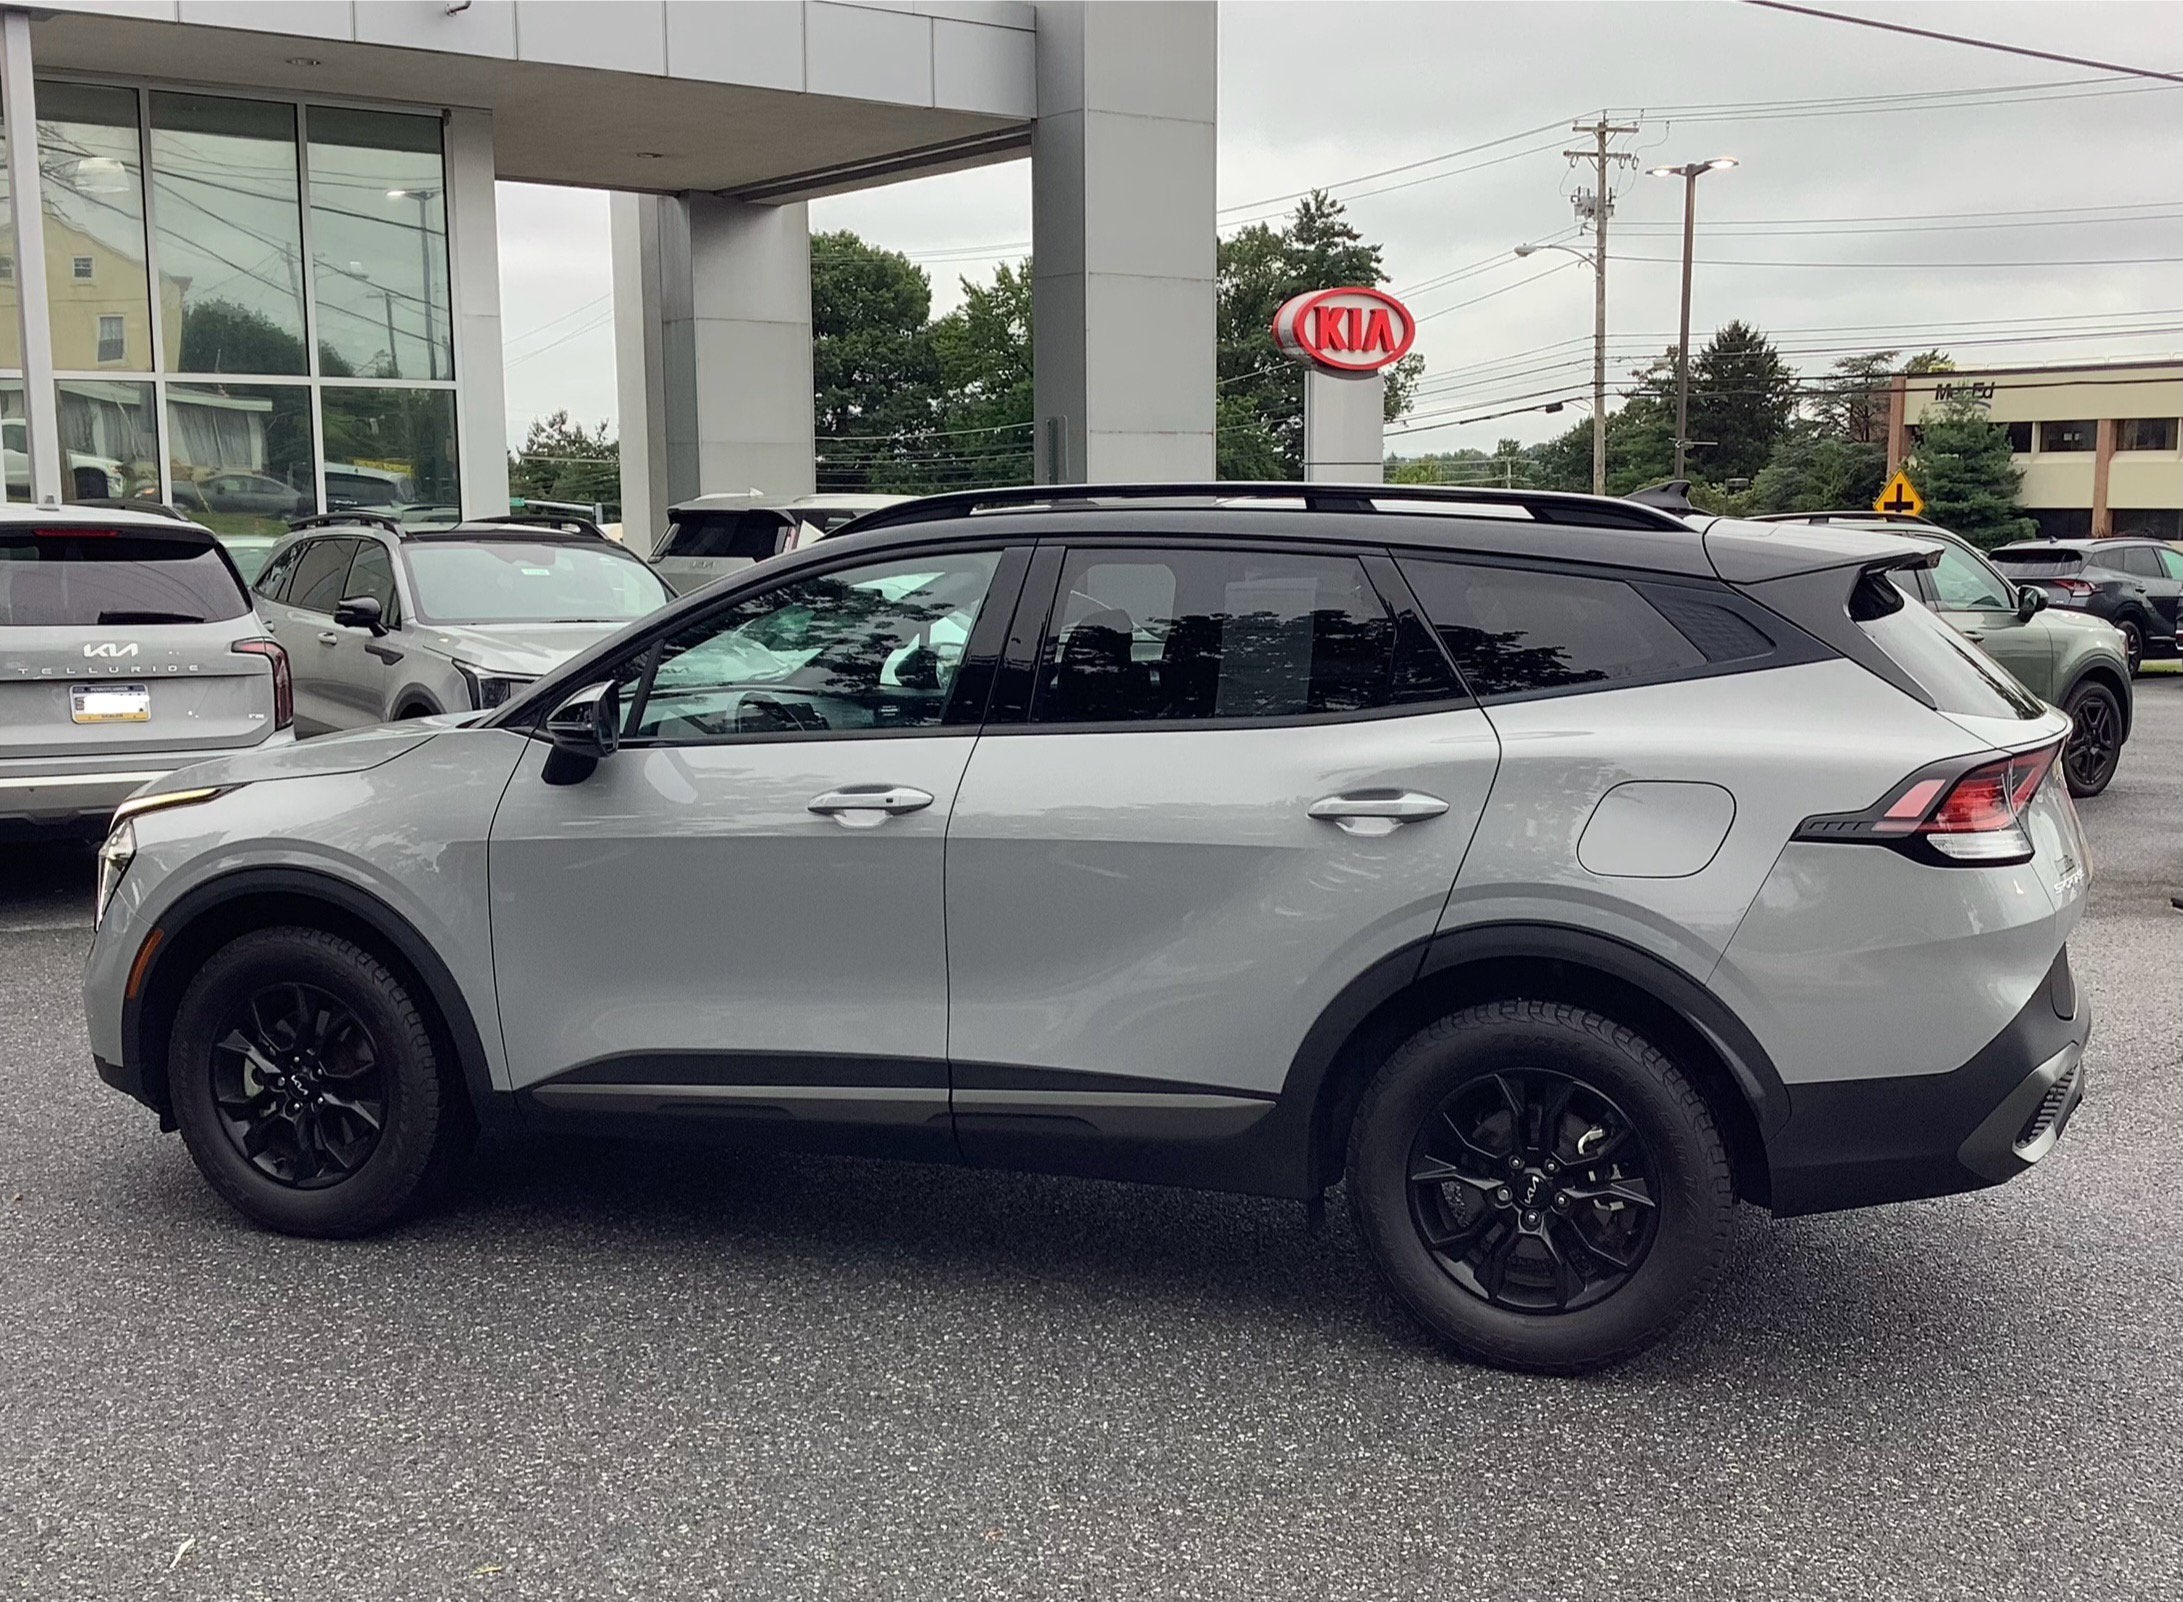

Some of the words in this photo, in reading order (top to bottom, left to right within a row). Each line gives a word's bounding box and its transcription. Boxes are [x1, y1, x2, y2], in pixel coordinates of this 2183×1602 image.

[1313, 306, 1396, 352] KIA
[83, 643, 138, 657] KIA
[18, 664, 199, 675] TELLURIDE
